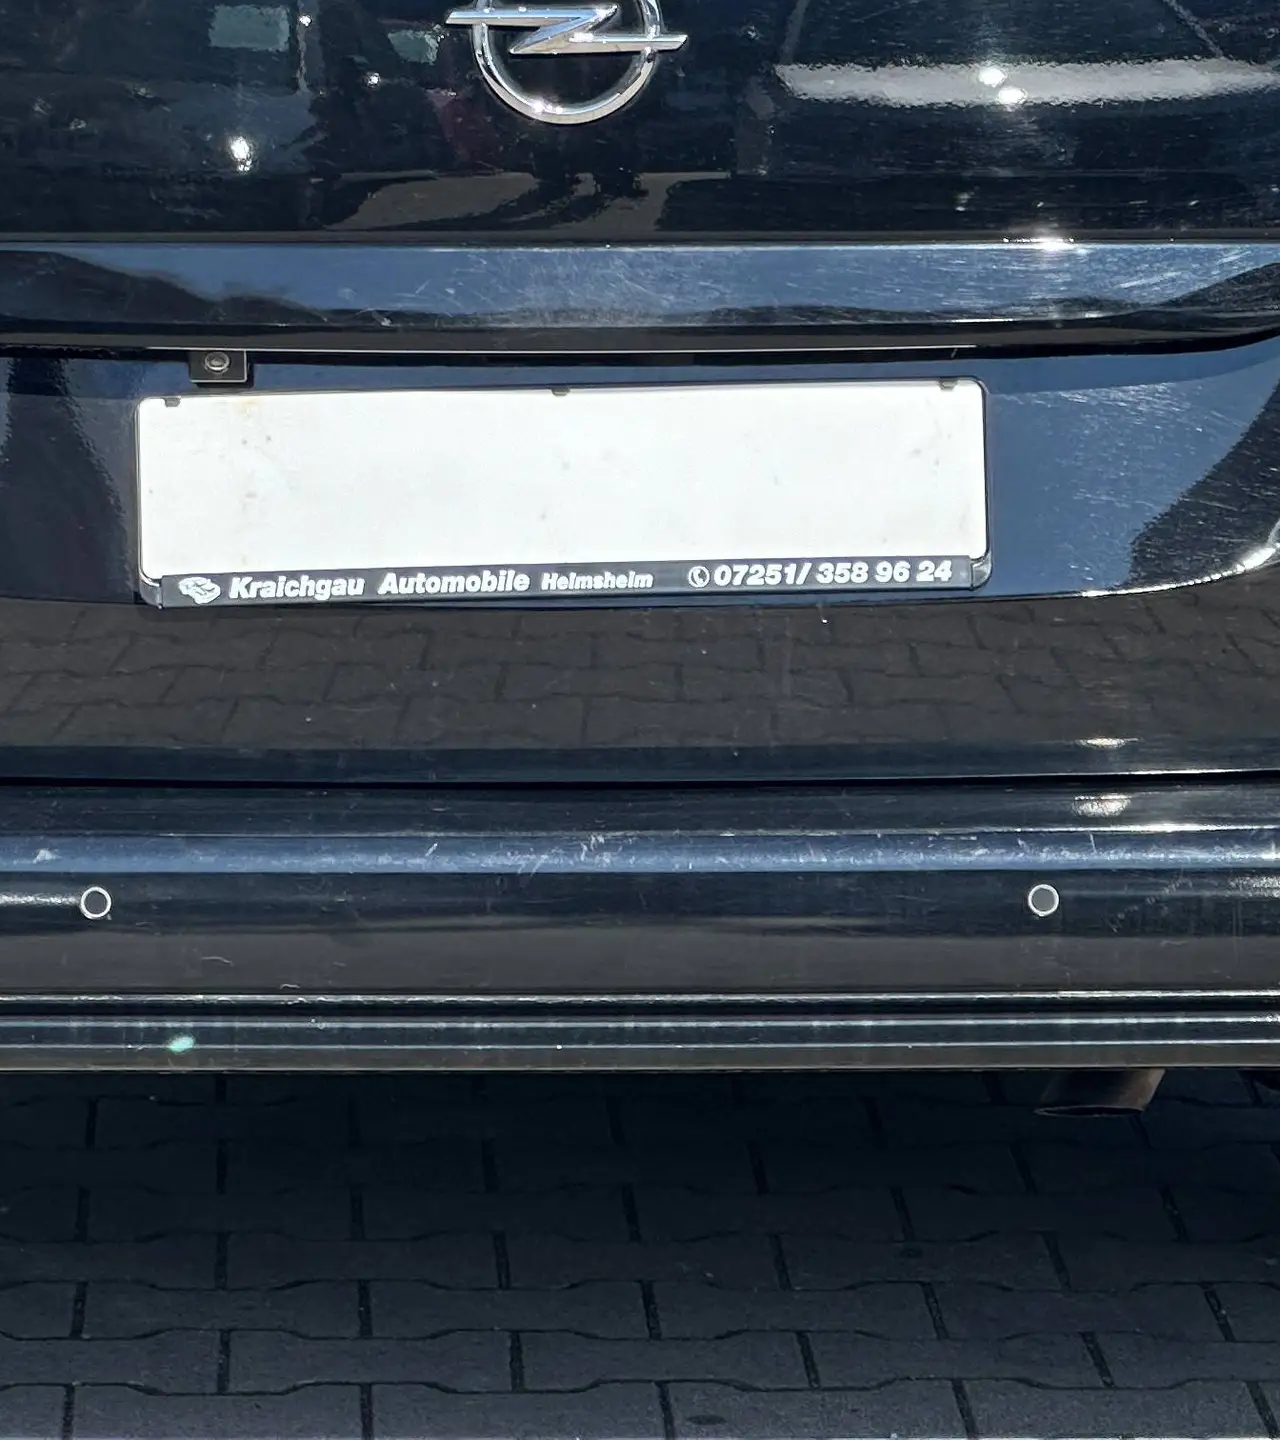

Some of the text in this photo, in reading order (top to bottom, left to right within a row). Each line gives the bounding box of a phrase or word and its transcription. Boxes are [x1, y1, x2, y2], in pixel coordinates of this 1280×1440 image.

[228, 575, 365, 601] Kraichgau
[377, 570, 530, 595] Automobile
[713, 563, 812, 587] 07251/
[816, 561, 869, 585] 358
[874, 561, 910, 584] 96
[916, 560, 952, 583] 24
